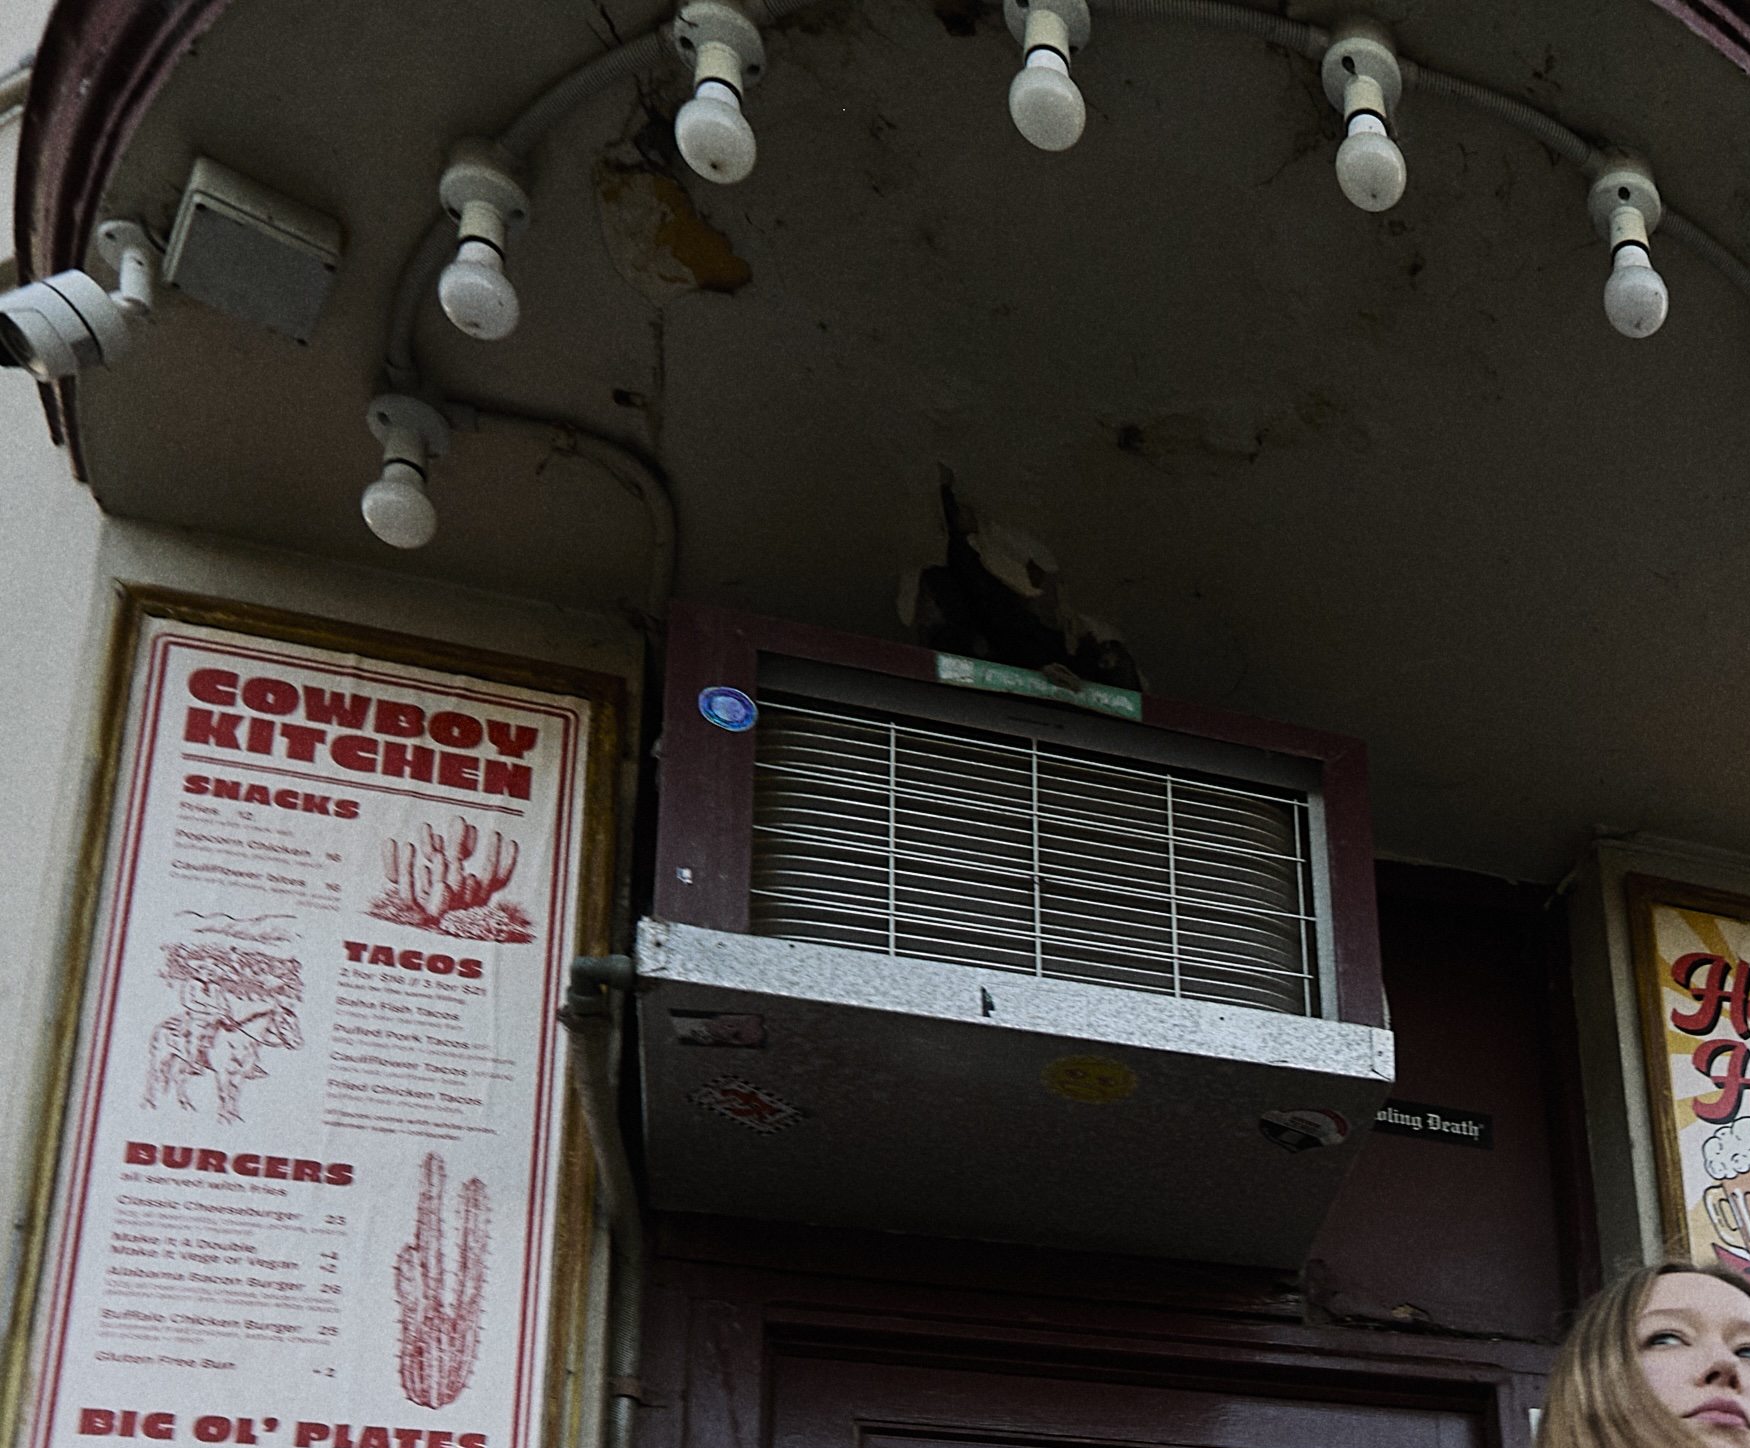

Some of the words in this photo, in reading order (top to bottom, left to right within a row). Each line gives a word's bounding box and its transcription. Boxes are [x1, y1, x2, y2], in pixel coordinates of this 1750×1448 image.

[187, 666, 540, 760] COWBOY
[182, 706, 533, 801] KITCHEN
[182, 774, 361, 819] SNACKS
[343, 940, 484, 979] TACOS
[1375, 1107, 1424, 1131] oling
[124, 1141, 355, 1186] BURGERS
[77, 1407, 177, 1441] BIG
